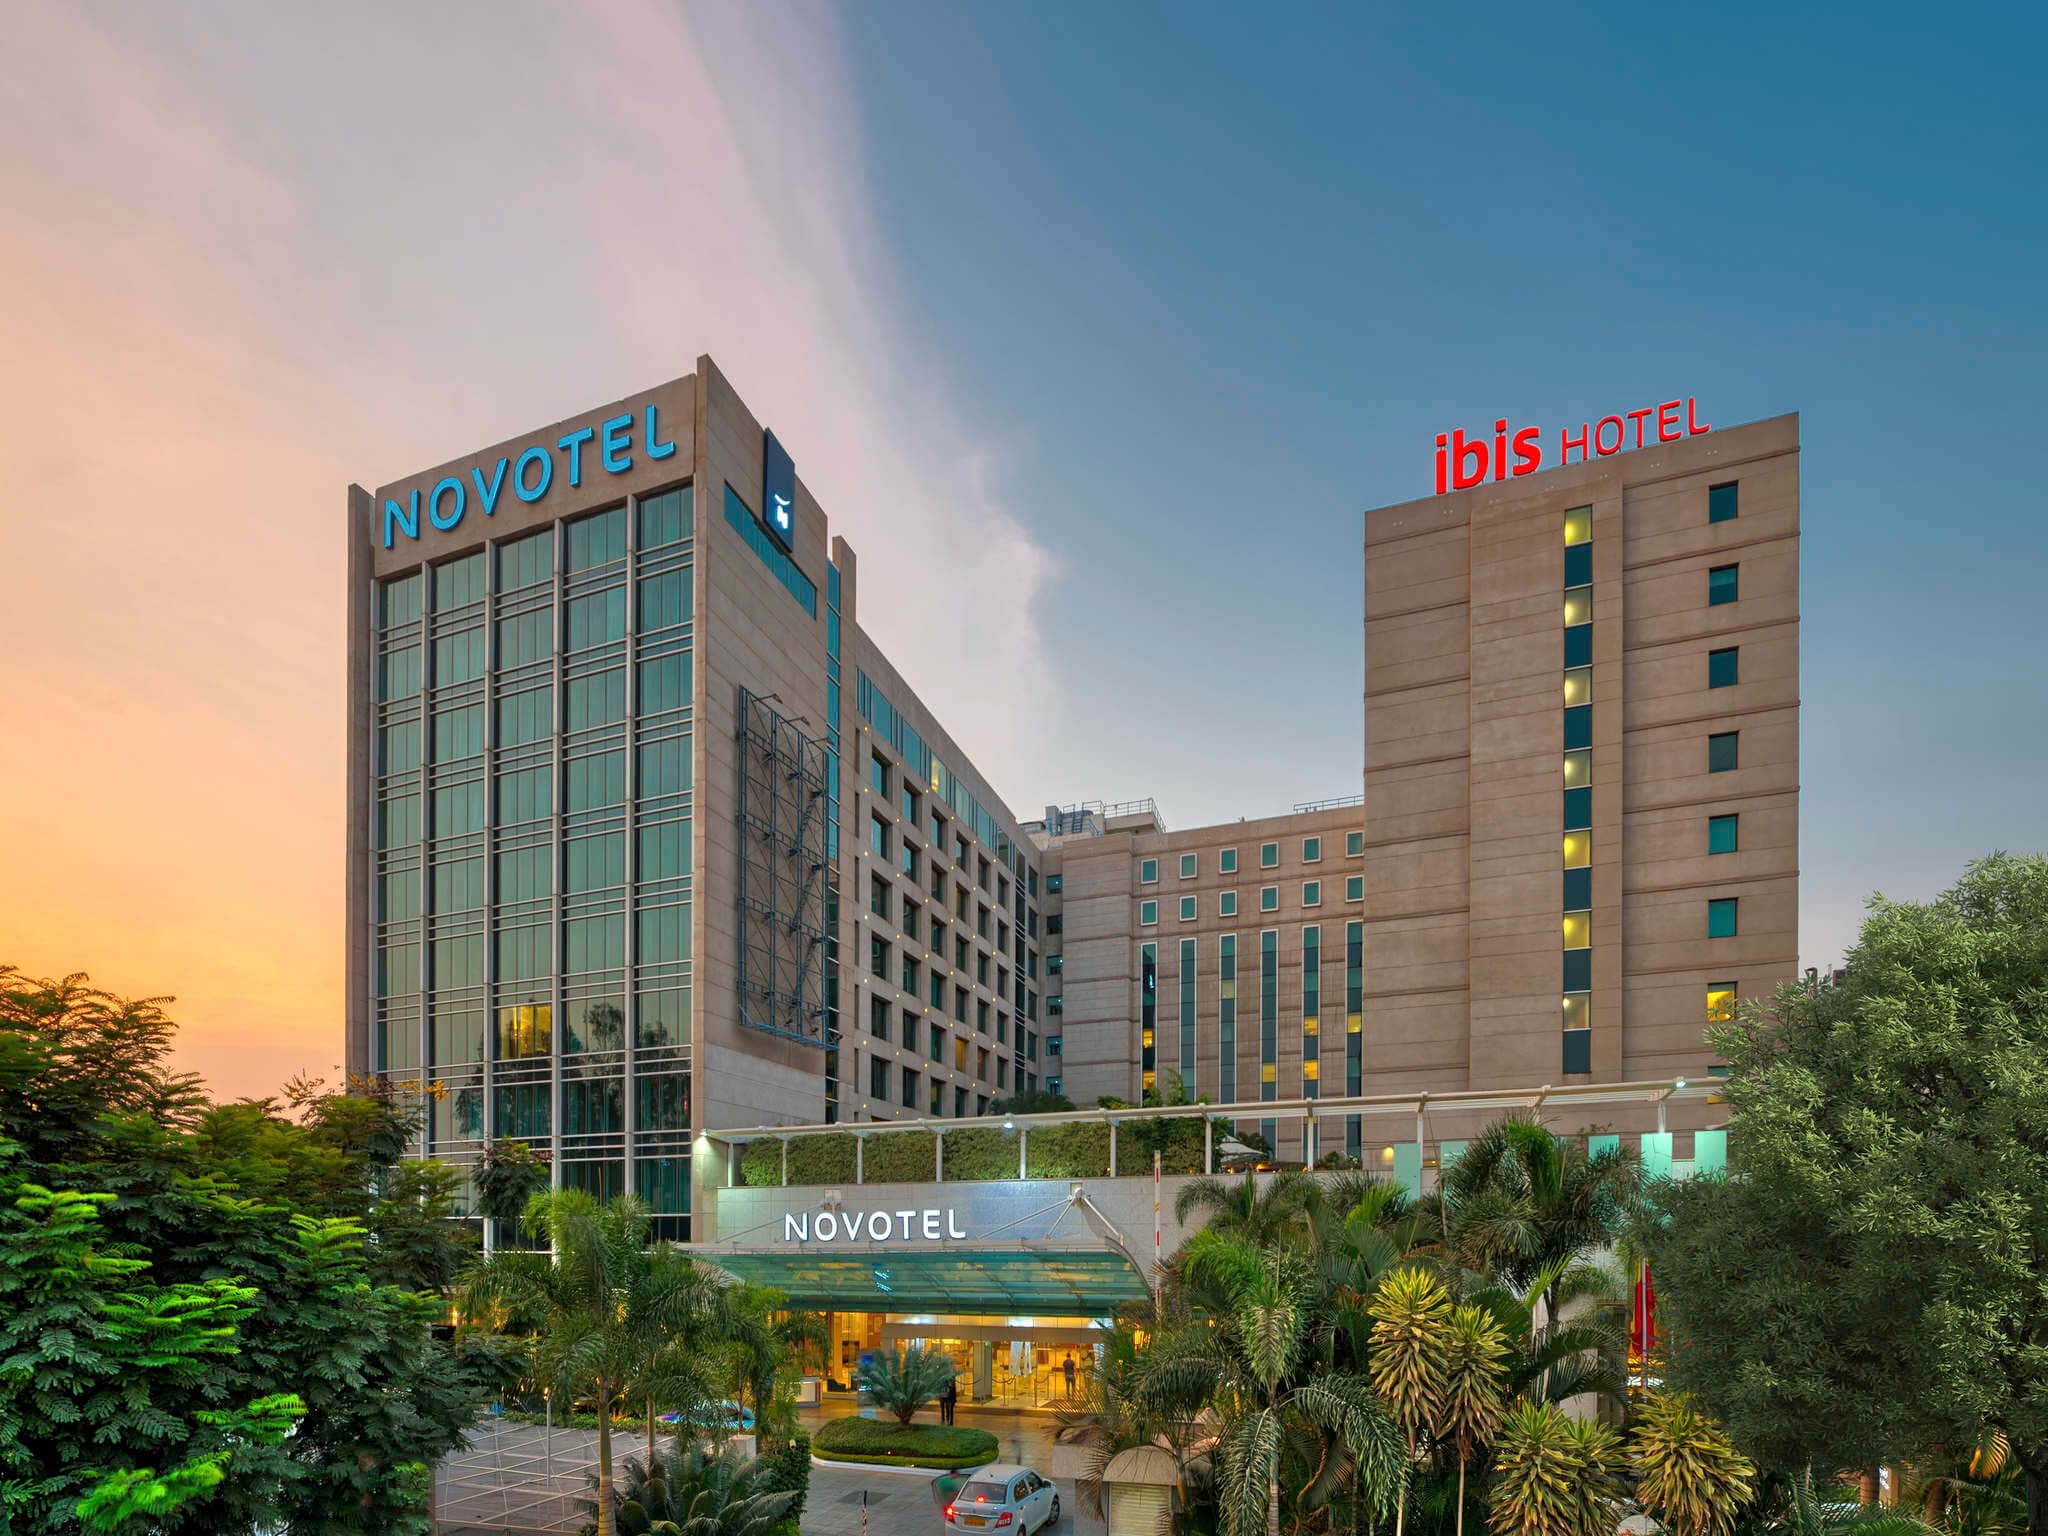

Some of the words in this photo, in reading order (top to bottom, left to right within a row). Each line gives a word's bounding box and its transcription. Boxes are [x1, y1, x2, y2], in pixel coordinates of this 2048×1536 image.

[382, 404, 676, 549] NOVOTEL
[1435, 418, 1541, 495] ibis
[1561, 397, 1711, 465] HOTEL
[784, 1208, 967, 1242] NOVOTEL
